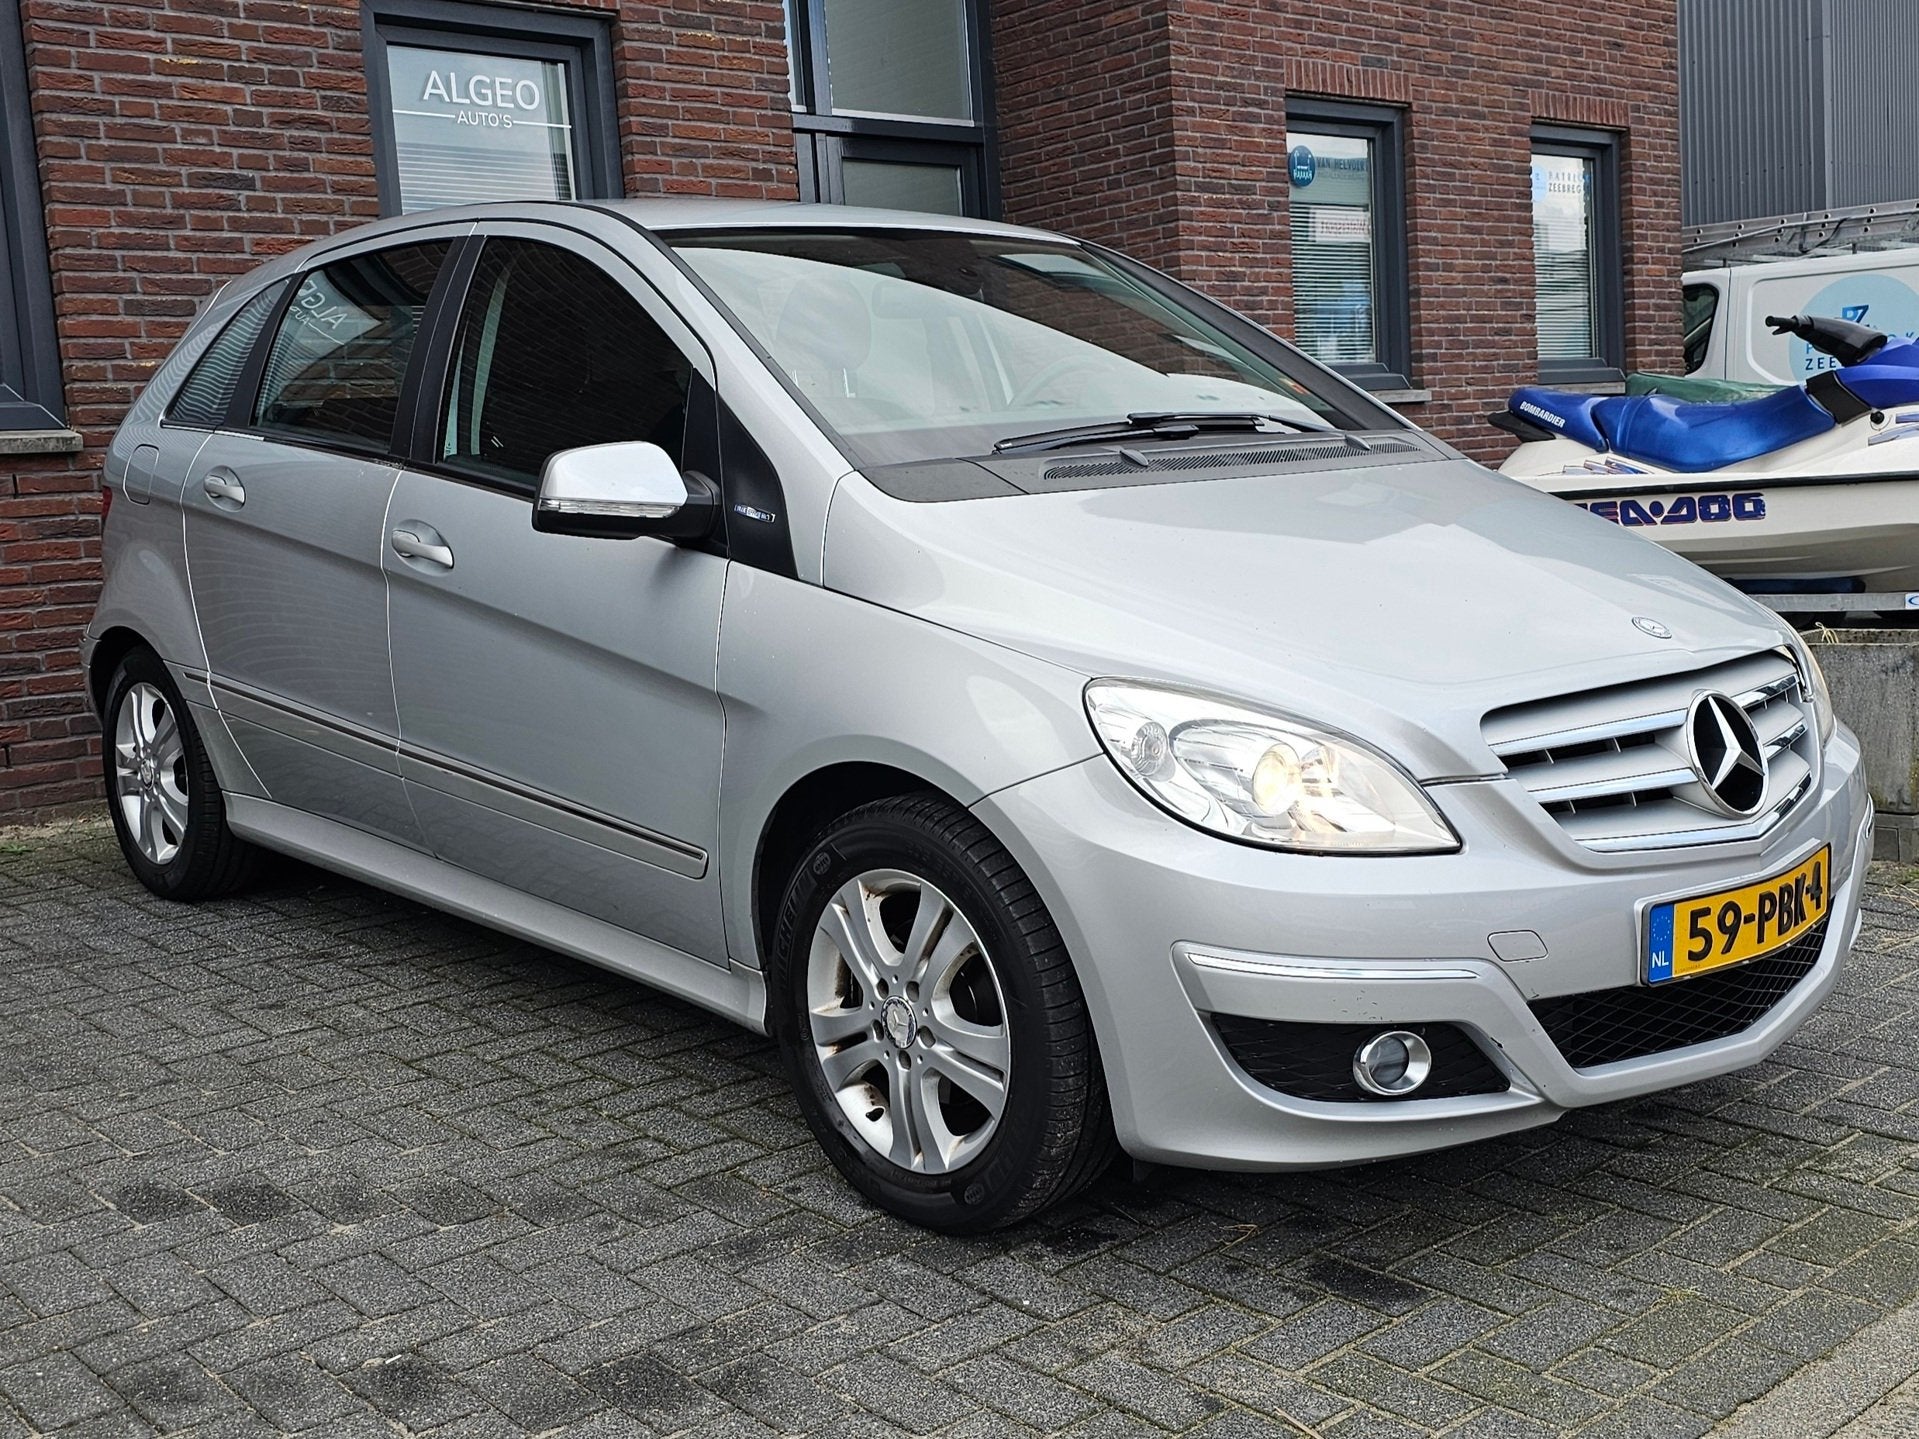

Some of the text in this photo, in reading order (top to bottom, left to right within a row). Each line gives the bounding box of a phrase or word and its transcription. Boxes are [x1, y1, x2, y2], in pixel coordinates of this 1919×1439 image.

[422, 70, 541, 111] ALGEO
[456, 110, 513, 128] AUTO'S
[1519, 400, 1566, 428] BOMBARDIER
[1687, 860, 1823, 962] 59-PBK-4
[1651, 951, 1669, 969] NL
